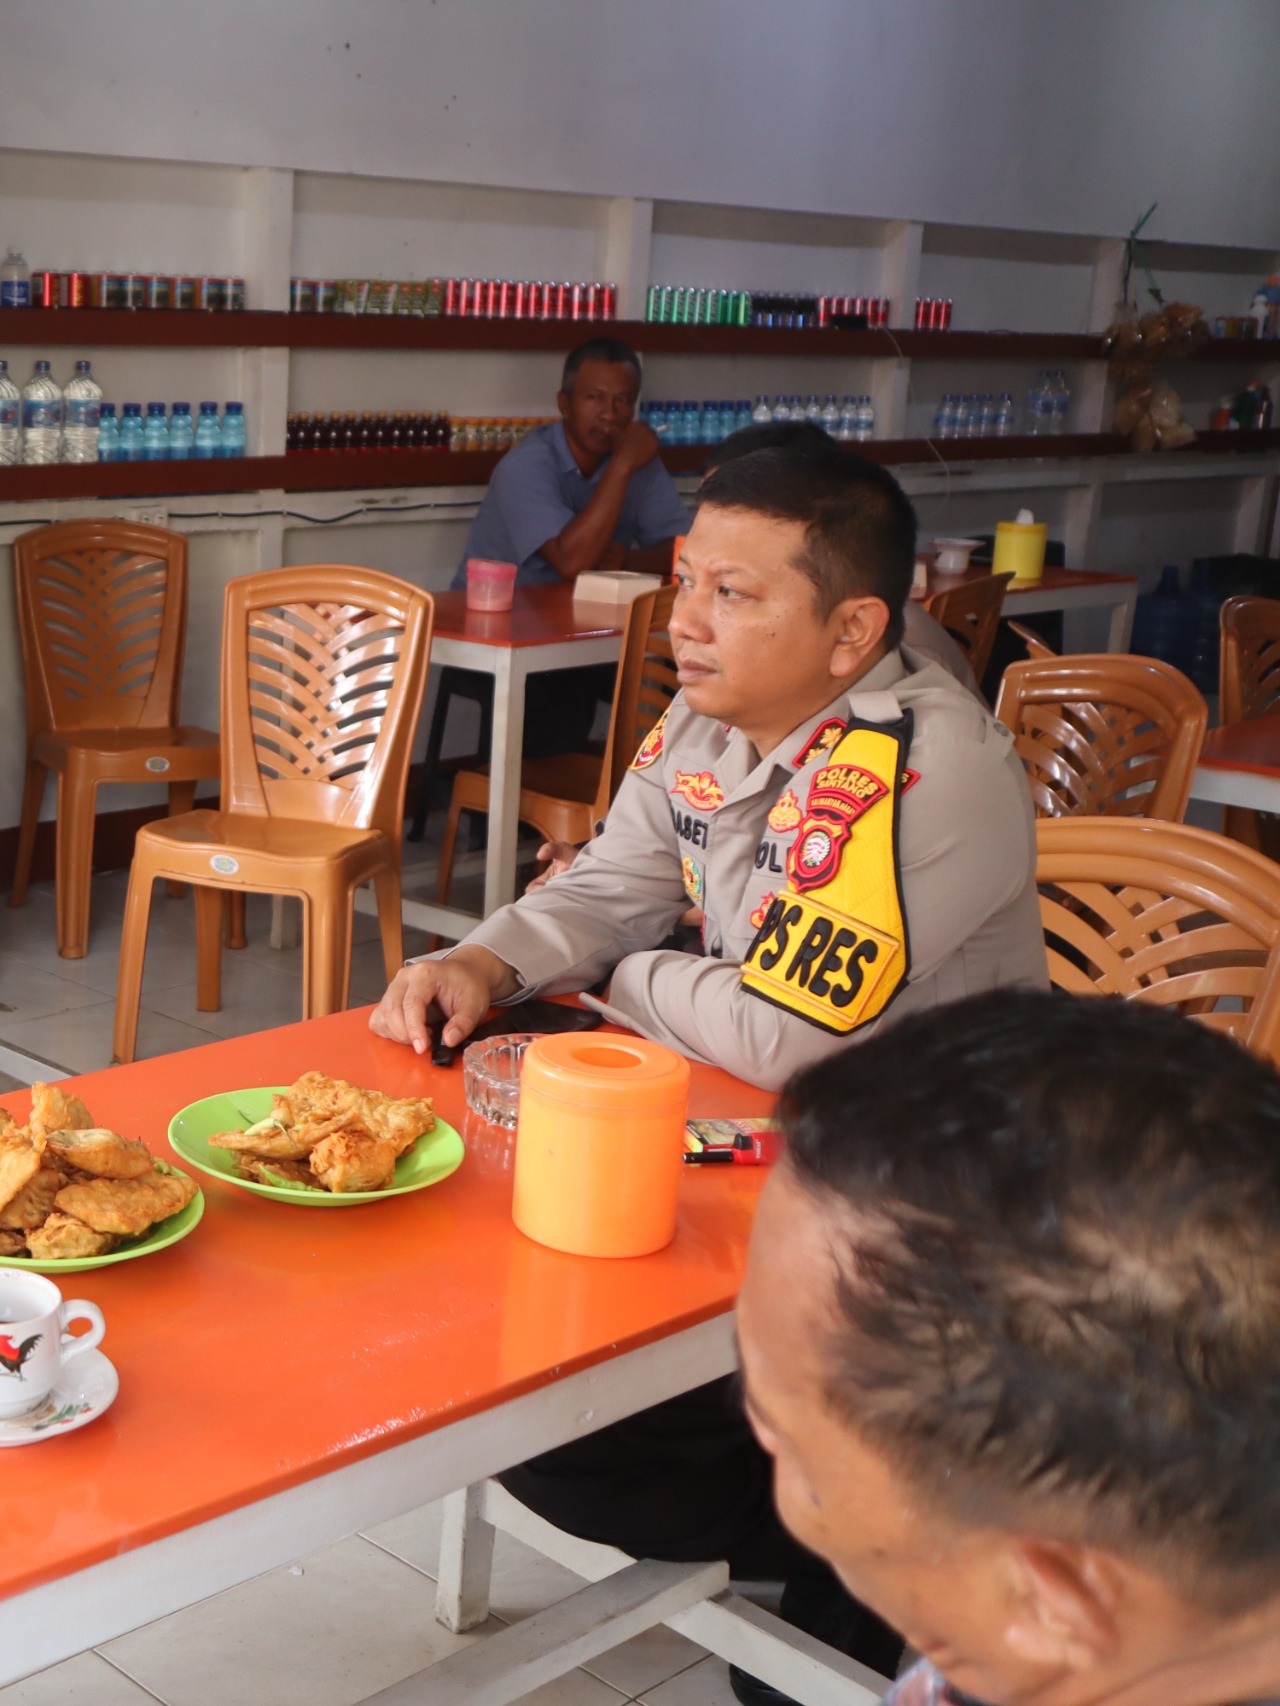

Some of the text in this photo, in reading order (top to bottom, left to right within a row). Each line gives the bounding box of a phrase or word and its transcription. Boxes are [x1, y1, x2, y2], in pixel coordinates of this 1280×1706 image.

[816, 767, 879, 795] POLRES
[816, 780, 867, 799] SINTANG
[785, 915, 879, 1008] RES
